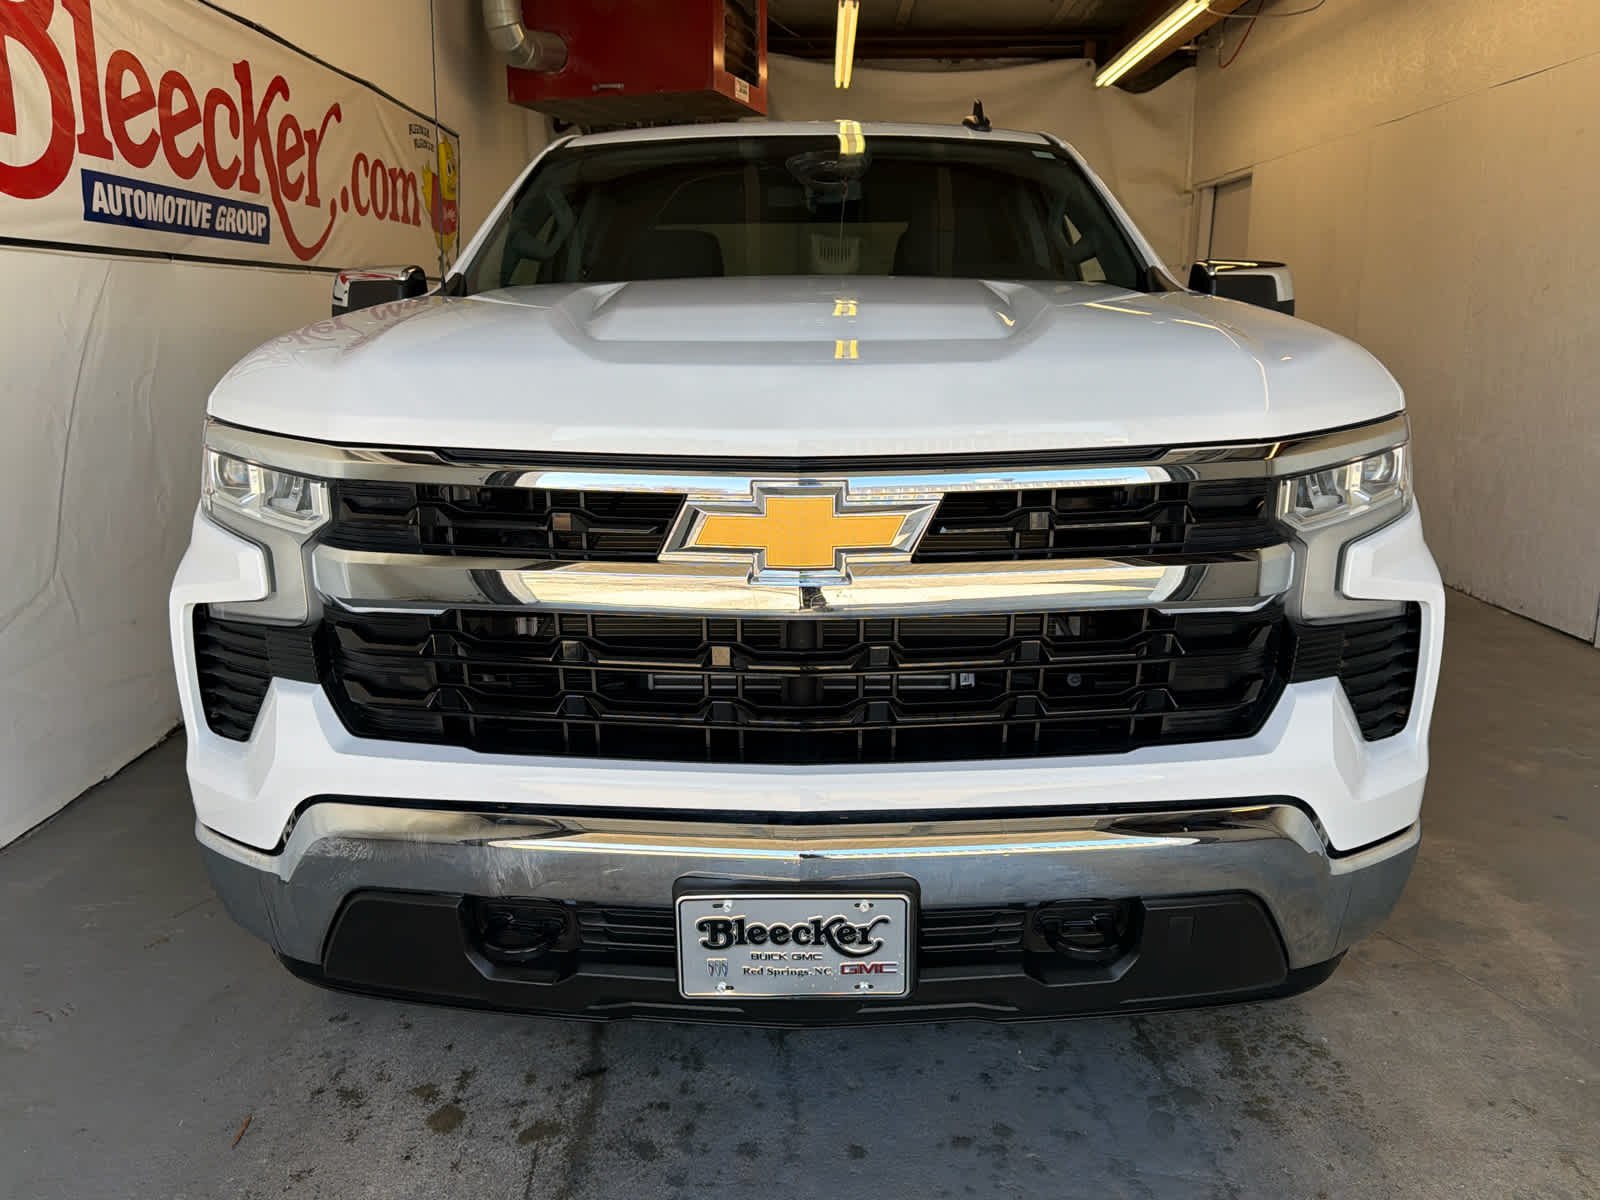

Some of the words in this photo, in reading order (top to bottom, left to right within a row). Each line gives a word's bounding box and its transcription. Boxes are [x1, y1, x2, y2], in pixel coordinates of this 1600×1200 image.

[92, 181, 212, 230] AUTOMOTIVE
[215, 206, 267, 237] GROUP
[696, 914, 891, 957] Bleecker
[750, 952, 788, 961] BUICK
[791, 952, 824, 961] GMC
[742, 966, 763, 976] Red
[840, 962, 897, 975] GMC
